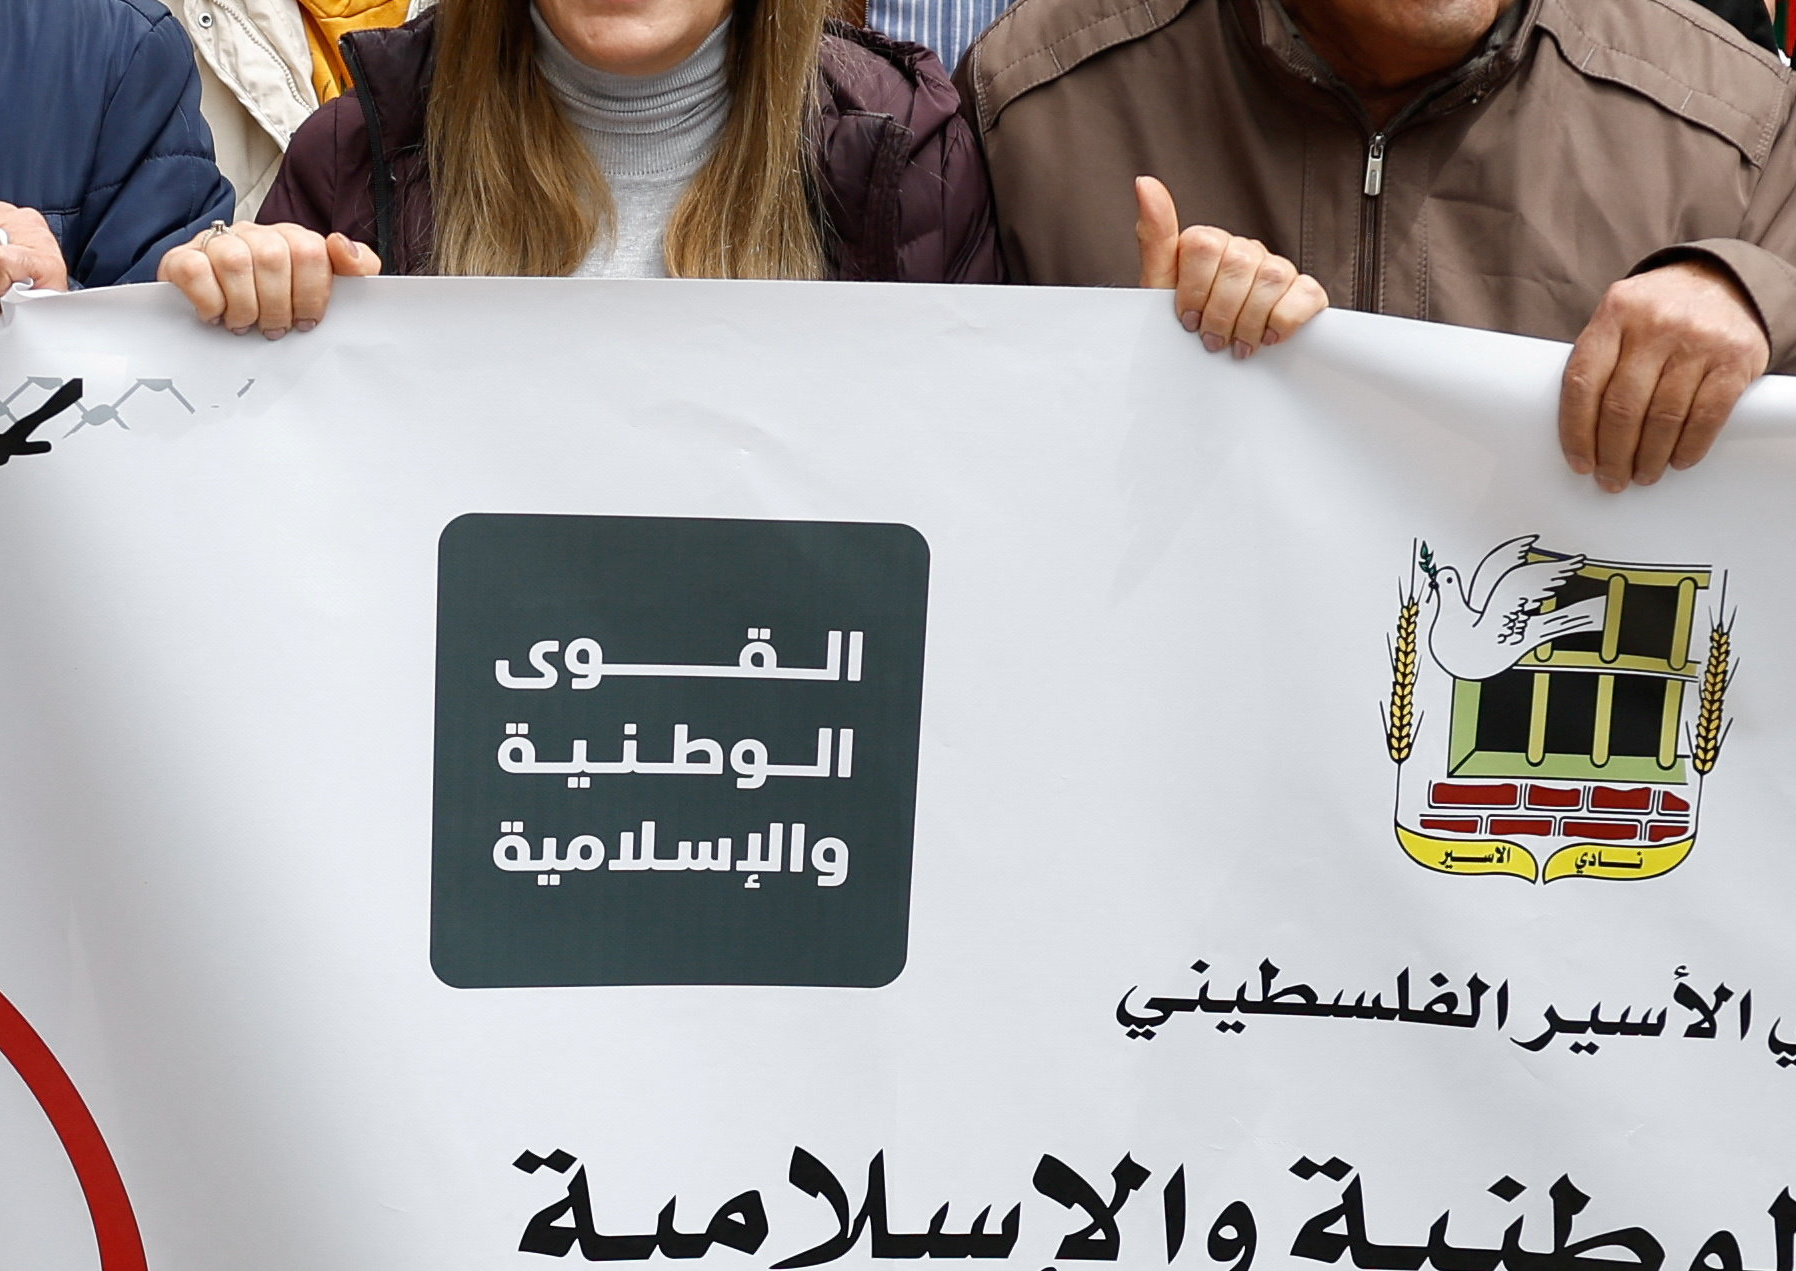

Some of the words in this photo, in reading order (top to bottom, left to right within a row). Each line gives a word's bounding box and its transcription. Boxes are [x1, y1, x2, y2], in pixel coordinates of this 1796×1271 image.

[496, 628, 863, 689] القوى
[498, 723, 853, 788] الوطنية
[493, 821, 848, 888] والإسلامية
[1574, 850, 1643, 874] نادي
[1117, 958, 1508, 1040] الفلسطيني
[1510, 966, 1751, 1055] الأسير
